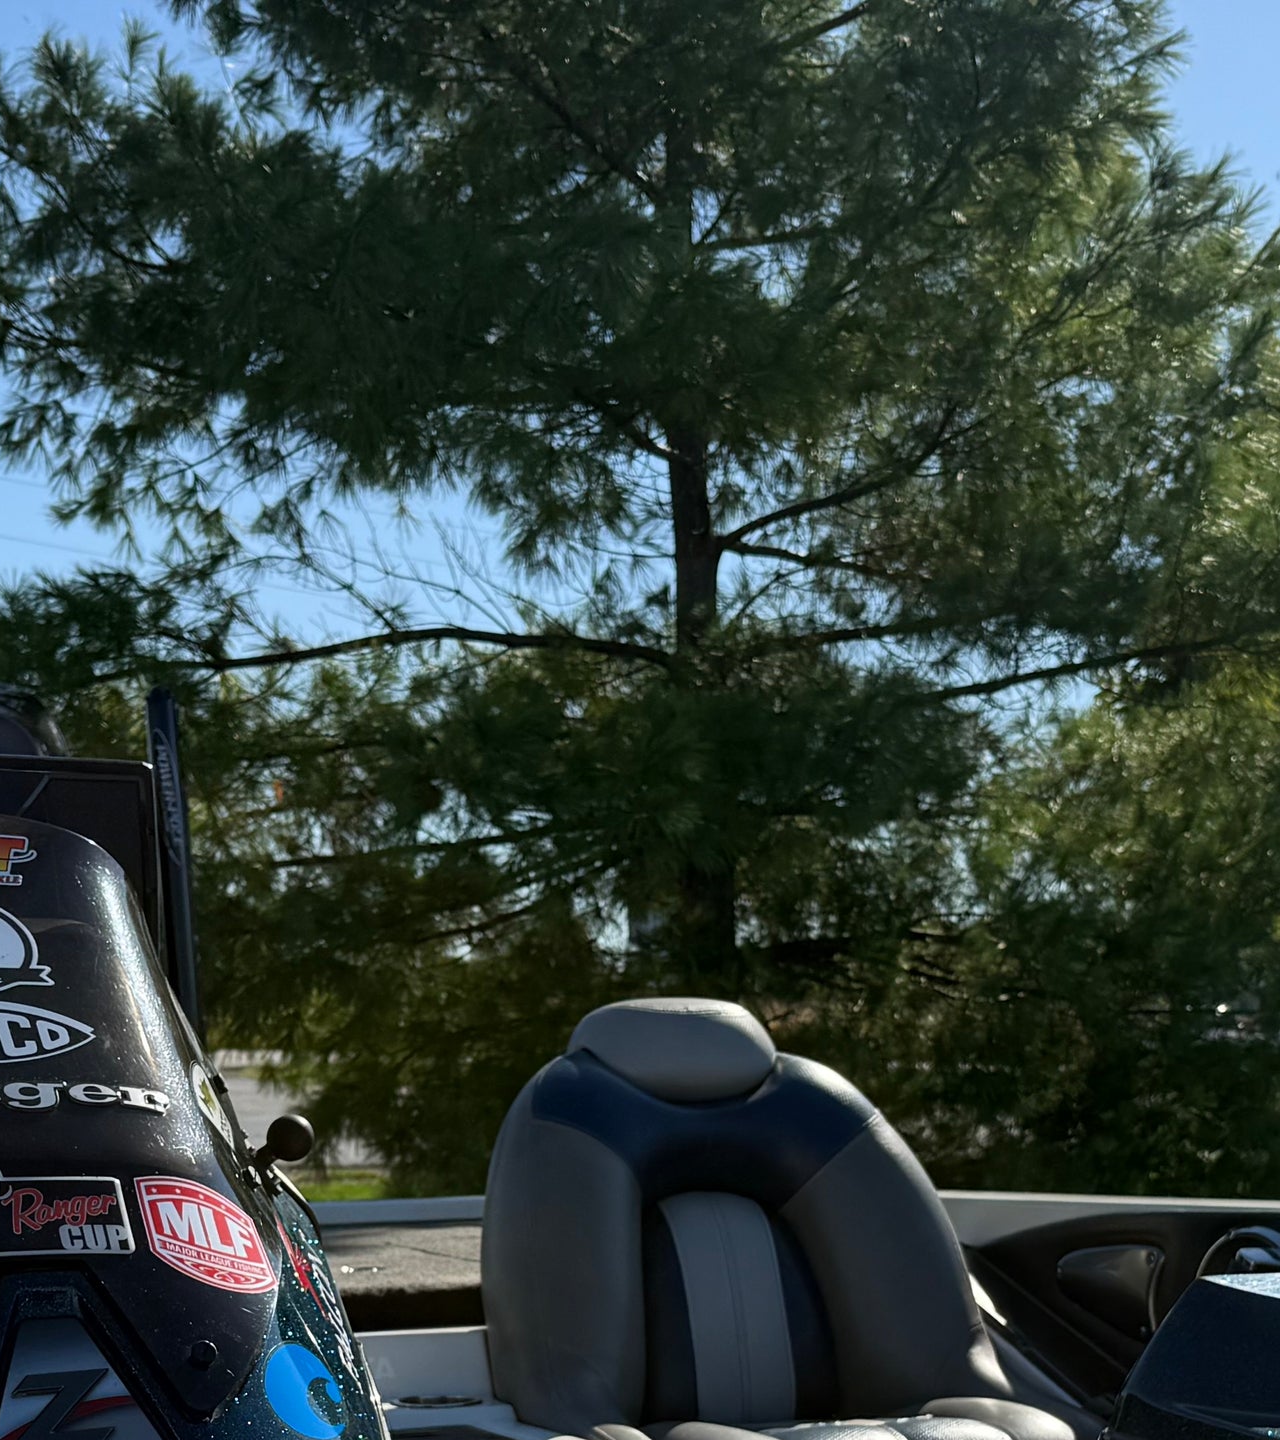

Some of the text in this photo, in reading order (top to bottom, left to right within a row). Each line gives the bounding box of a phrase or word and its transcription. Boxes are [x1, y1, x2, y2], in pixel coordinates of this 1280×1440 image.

[1, 1187, 117, 1235] Ranger
[156, 1201, 253, 1259] MLF
[58, 1224, 128, 1252] CUP
[166, 1241, 198, 1259] MAJOR
[200, 1251, 232, 1268] LEAGUE
